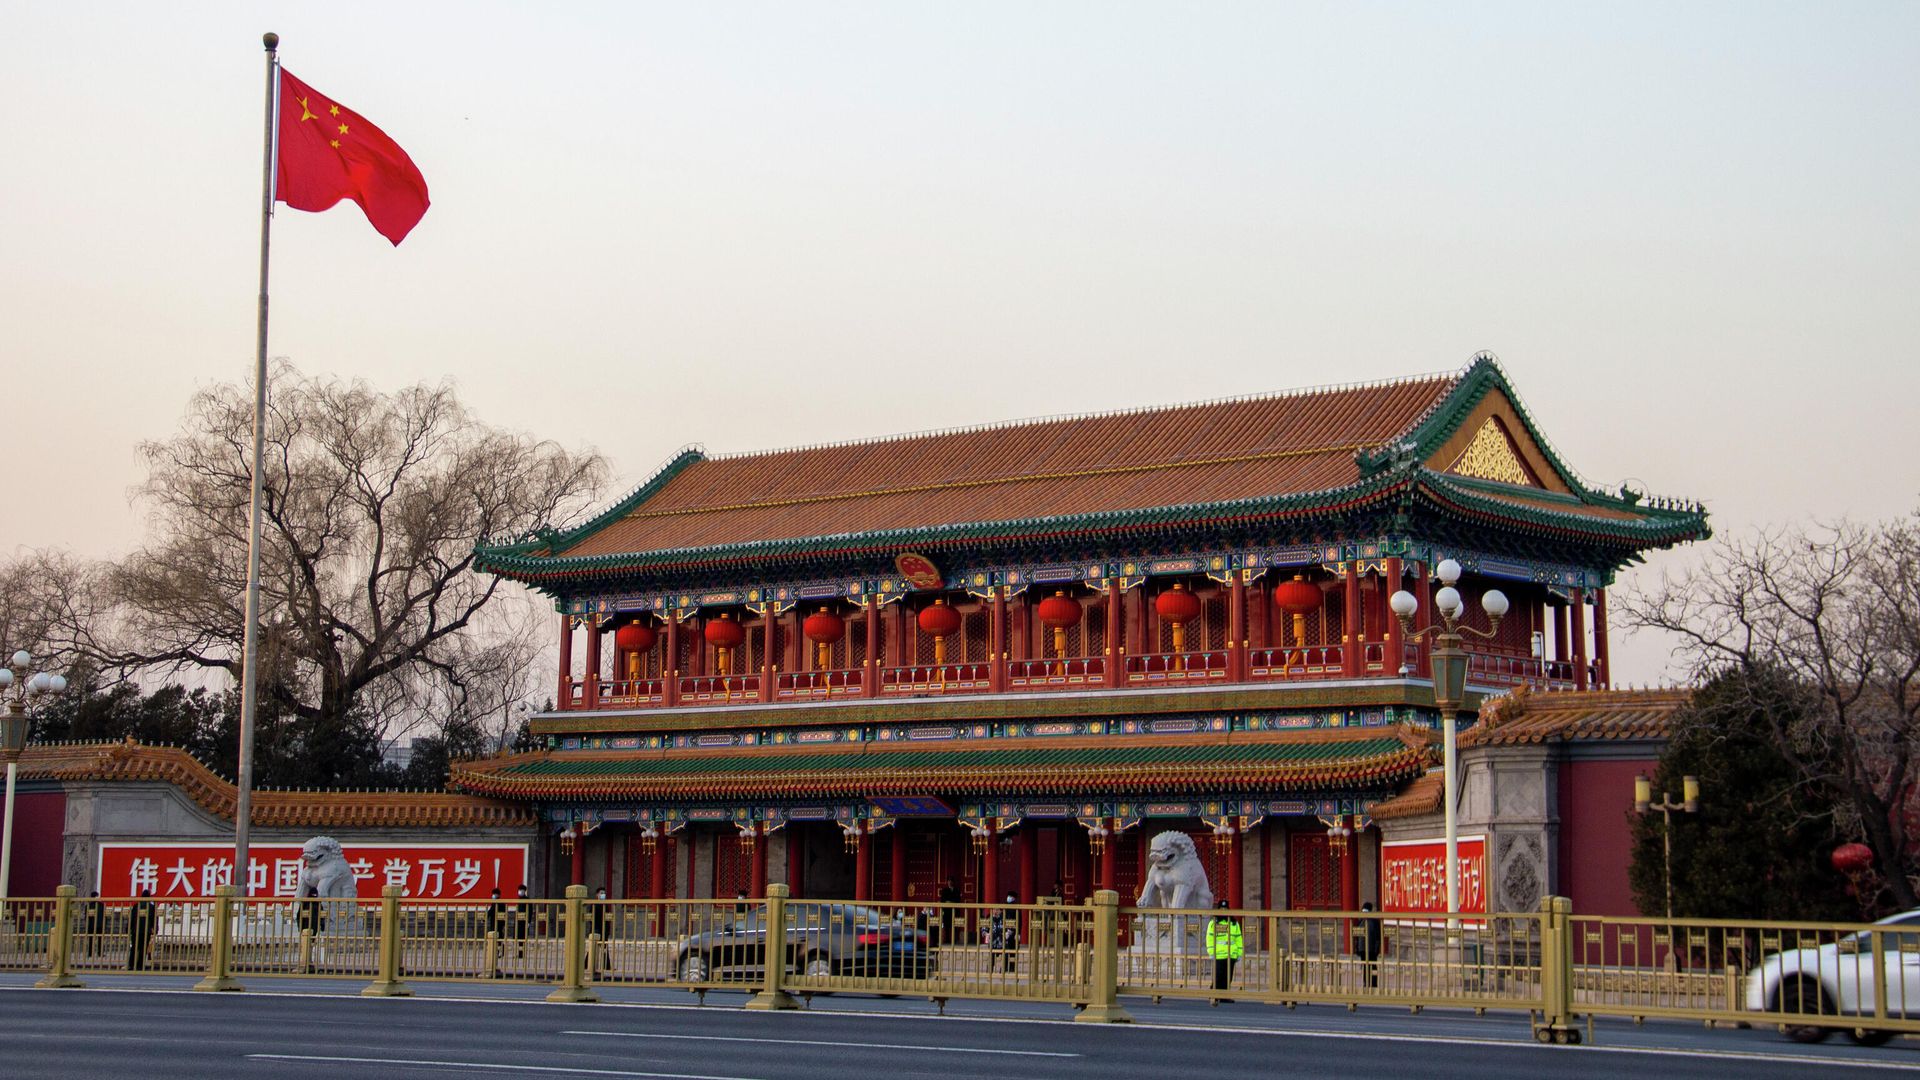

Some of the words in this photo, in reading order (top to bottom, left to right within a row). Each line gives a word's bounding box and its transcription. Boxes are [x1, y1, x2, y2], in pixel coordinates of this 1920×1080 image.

[129, 857, 500, 897] 伟大的中国产党万岁！
[1384, 856, 1484, 909] 战无不胜的毛泽东万岁！
